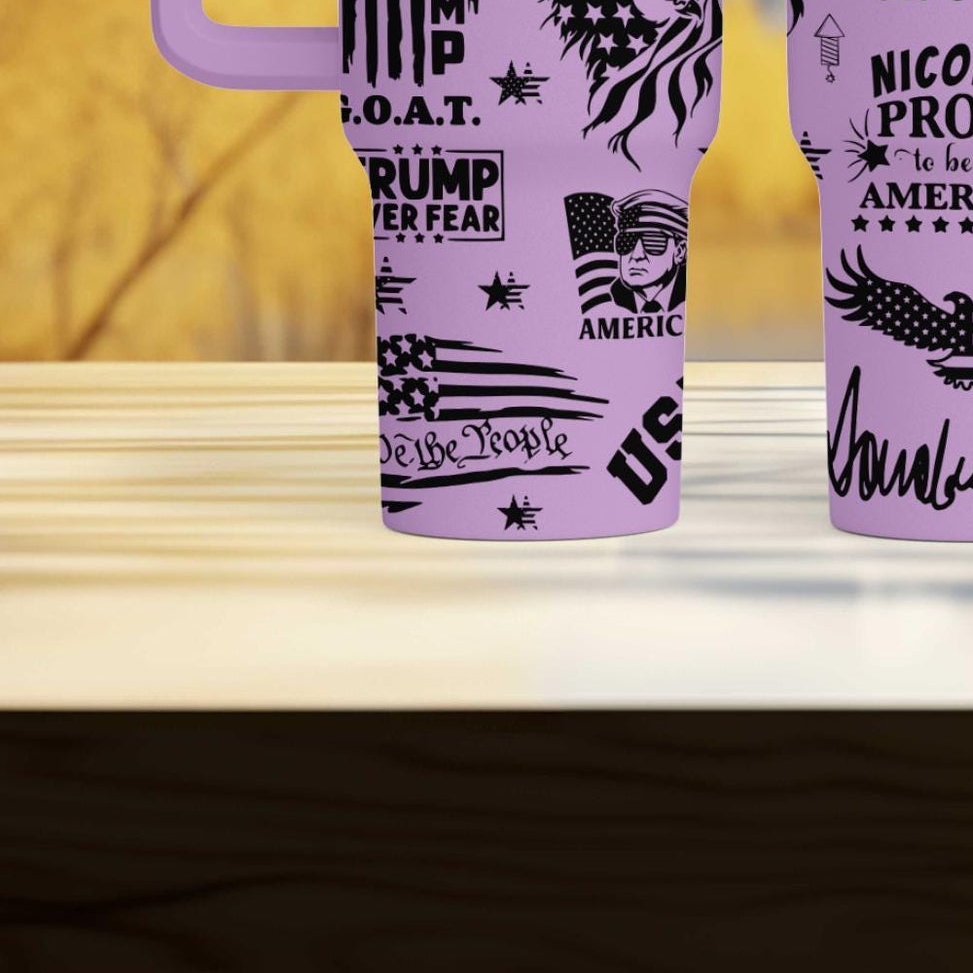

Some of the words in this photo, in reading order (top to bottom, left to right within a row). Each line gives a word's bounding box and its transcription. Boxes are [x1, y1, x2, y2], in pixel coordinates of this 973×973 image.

[911, 148, 934, 172] to
[945, 142, 973, 172] be
[358, 156, 500, 201] RUMP
[425, 204, 500, 232] FEAR
[578, 314, 683, 340] AMERIC
[456, 417, 573, 469] People
[606, 376, 683, 505] US
